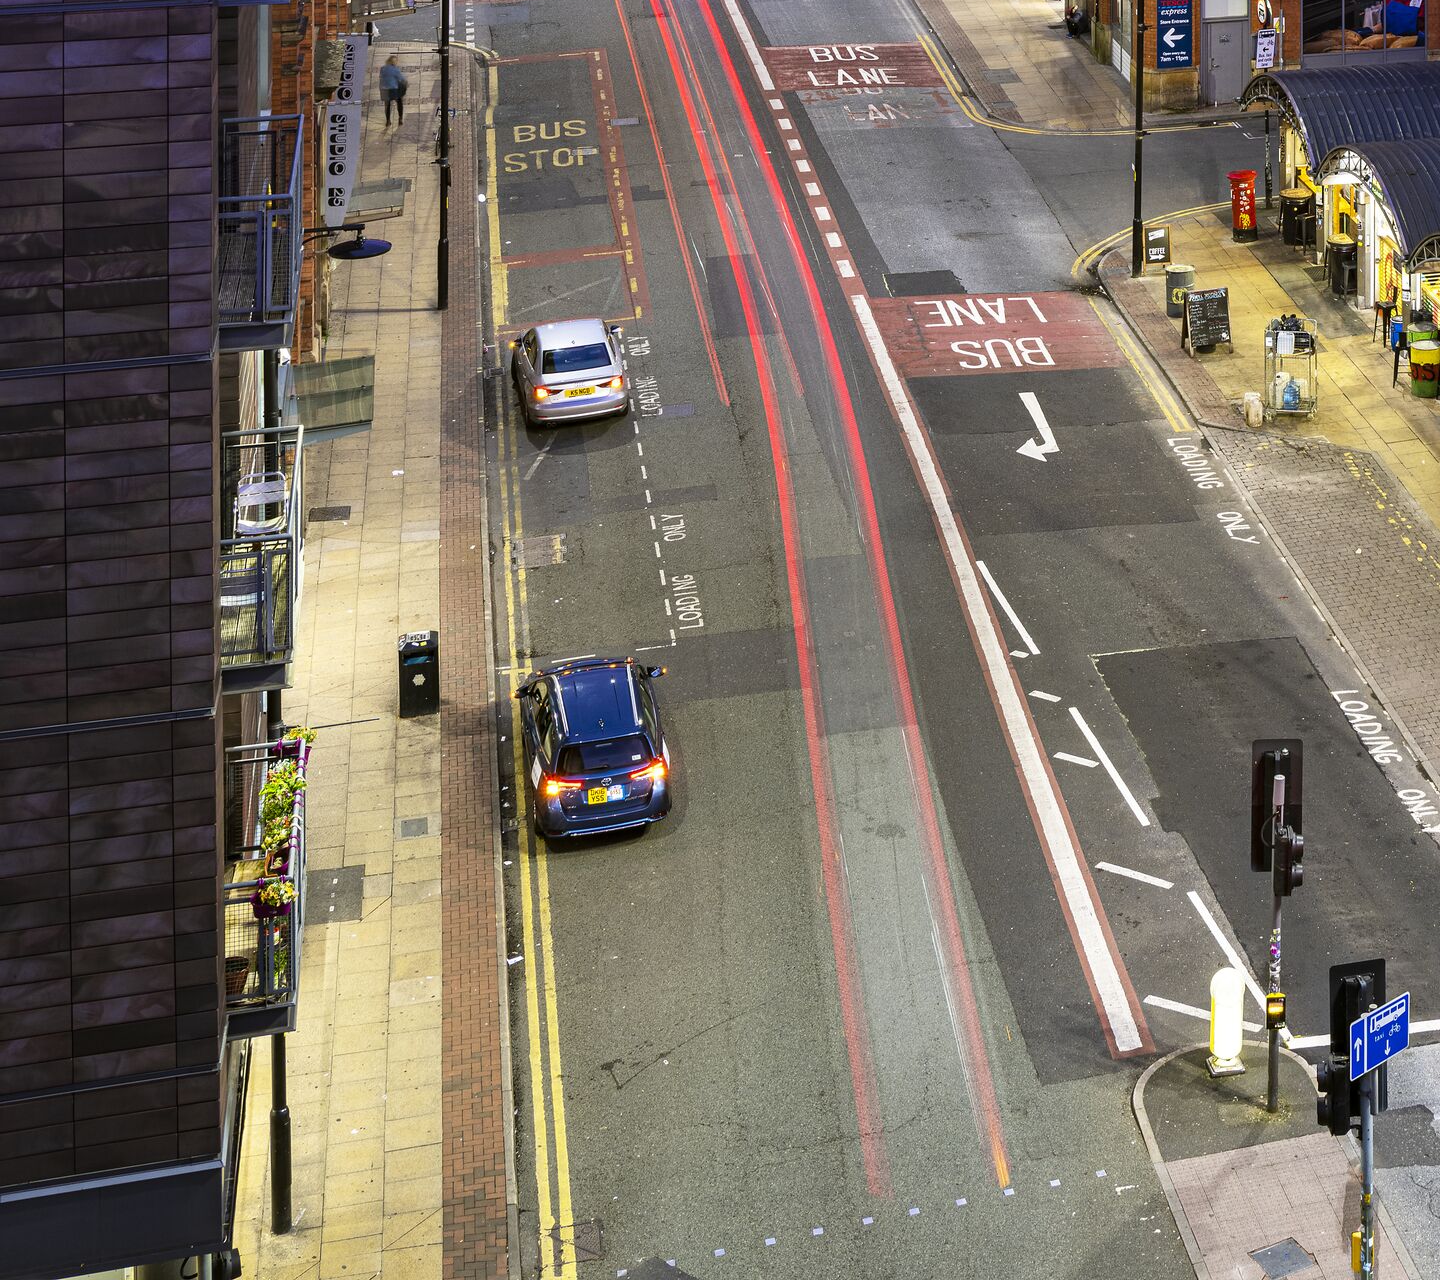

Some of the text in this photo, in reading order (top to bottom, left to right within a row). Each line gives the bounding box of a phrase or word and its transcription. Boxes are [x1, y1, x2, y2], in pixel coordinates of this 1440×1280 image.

[1161, 8, 1187, 16] express
[808, 46, 880, 63] BUS
[337, 44, 354, 101] STUDIO
[807, 68, 905, 87] LANE
[844, 103, 910, 122] LAN
[513, 120, 587, 143] BUS
[328, 114, 348, 208] STUDIO 25
[1148, 247, 1166, 255] COFFEE
[914, 296, 1048, 328] LANE
[950, 337, 1056, 369] BUS
[627, 335, 663, 418] LOADING ONLY
[1167, 436, 1260, 545] LOADING ONLY
[661, 512, 704, 630] LOADING ONLY
[1331, 689, 1403, 766] LOADING
[1374, 1032, 1385, 1042] taxi
